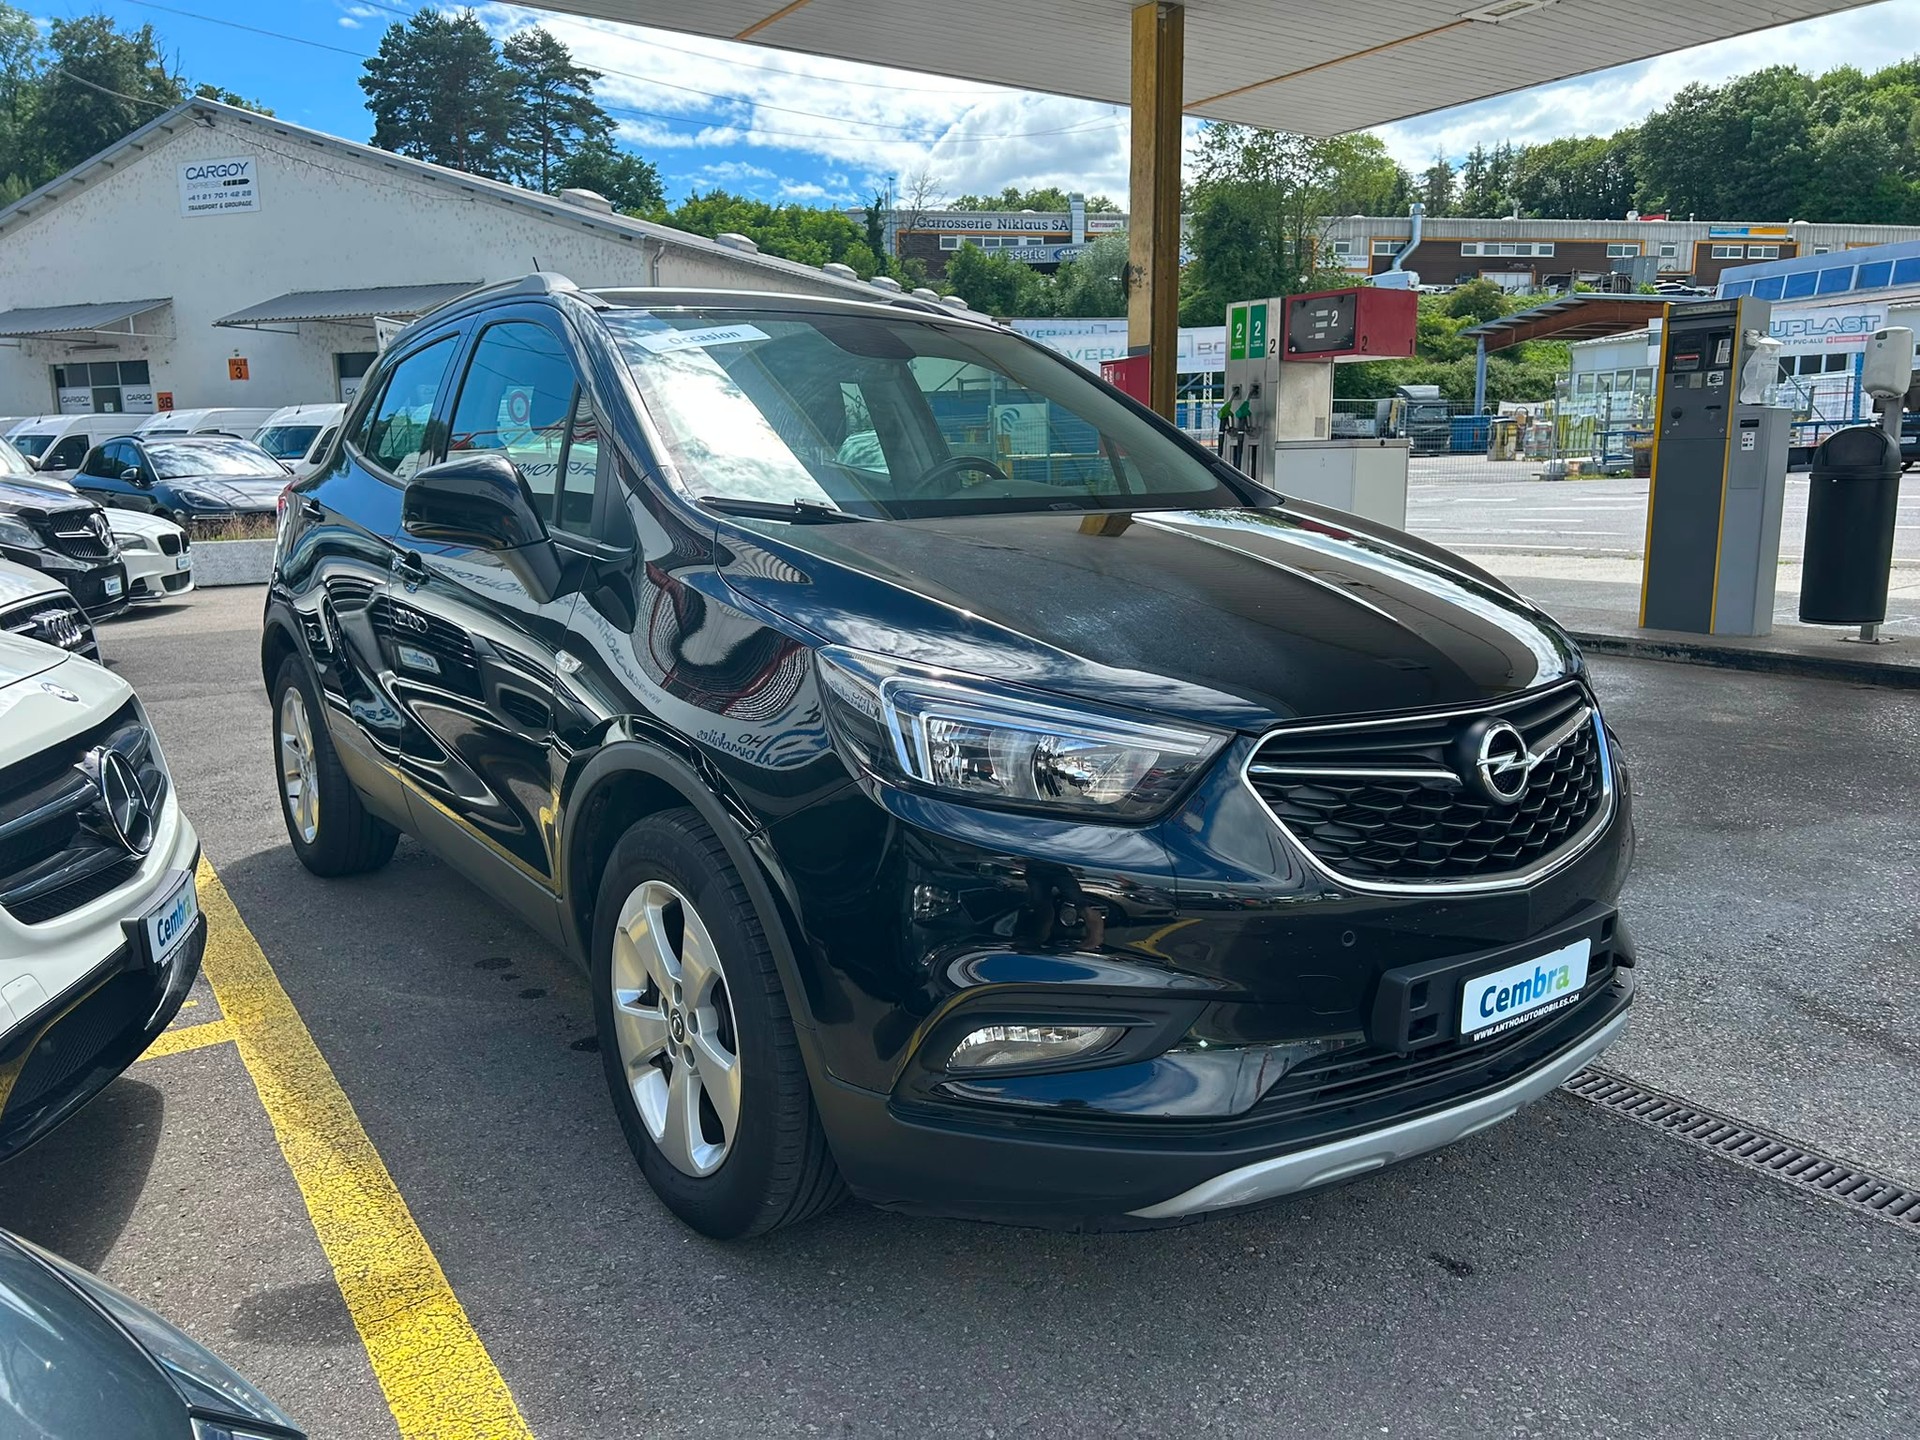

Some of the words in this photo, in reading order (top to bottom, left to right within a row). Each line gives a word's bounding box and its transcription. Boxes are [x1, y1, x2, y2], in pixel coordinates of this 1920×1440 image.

[185, 162, 249, 180] CARGOY
[188, 203, 218, 211] TRANSPORT
[916, 216, 993, 230] Carrosserie
[997, 218, 1048, 230] Niklaus
[1052, 219, 1069, 231] SA
[1331, 310, 1339, 327] 2
[1235, 323, 1243, 338] 2
[1254, 321, 1261, 337] 2
[1769, 315, 1880, 338] UPLAST
[668, 331, 741, 344] Occasion
[1361, 336, 1368, 352] 2
[1269, 338, 1276, 354] 2
[1408, 338, 1414, 353] 1
[235, 367, 243, 379] 3
[62, 395, 89, 403] CARGOY
[158, 397, 173, 409] 3B
[157, 895, 192, 947] Cembra
[1480, 964, 1570, 1018] Cembra
